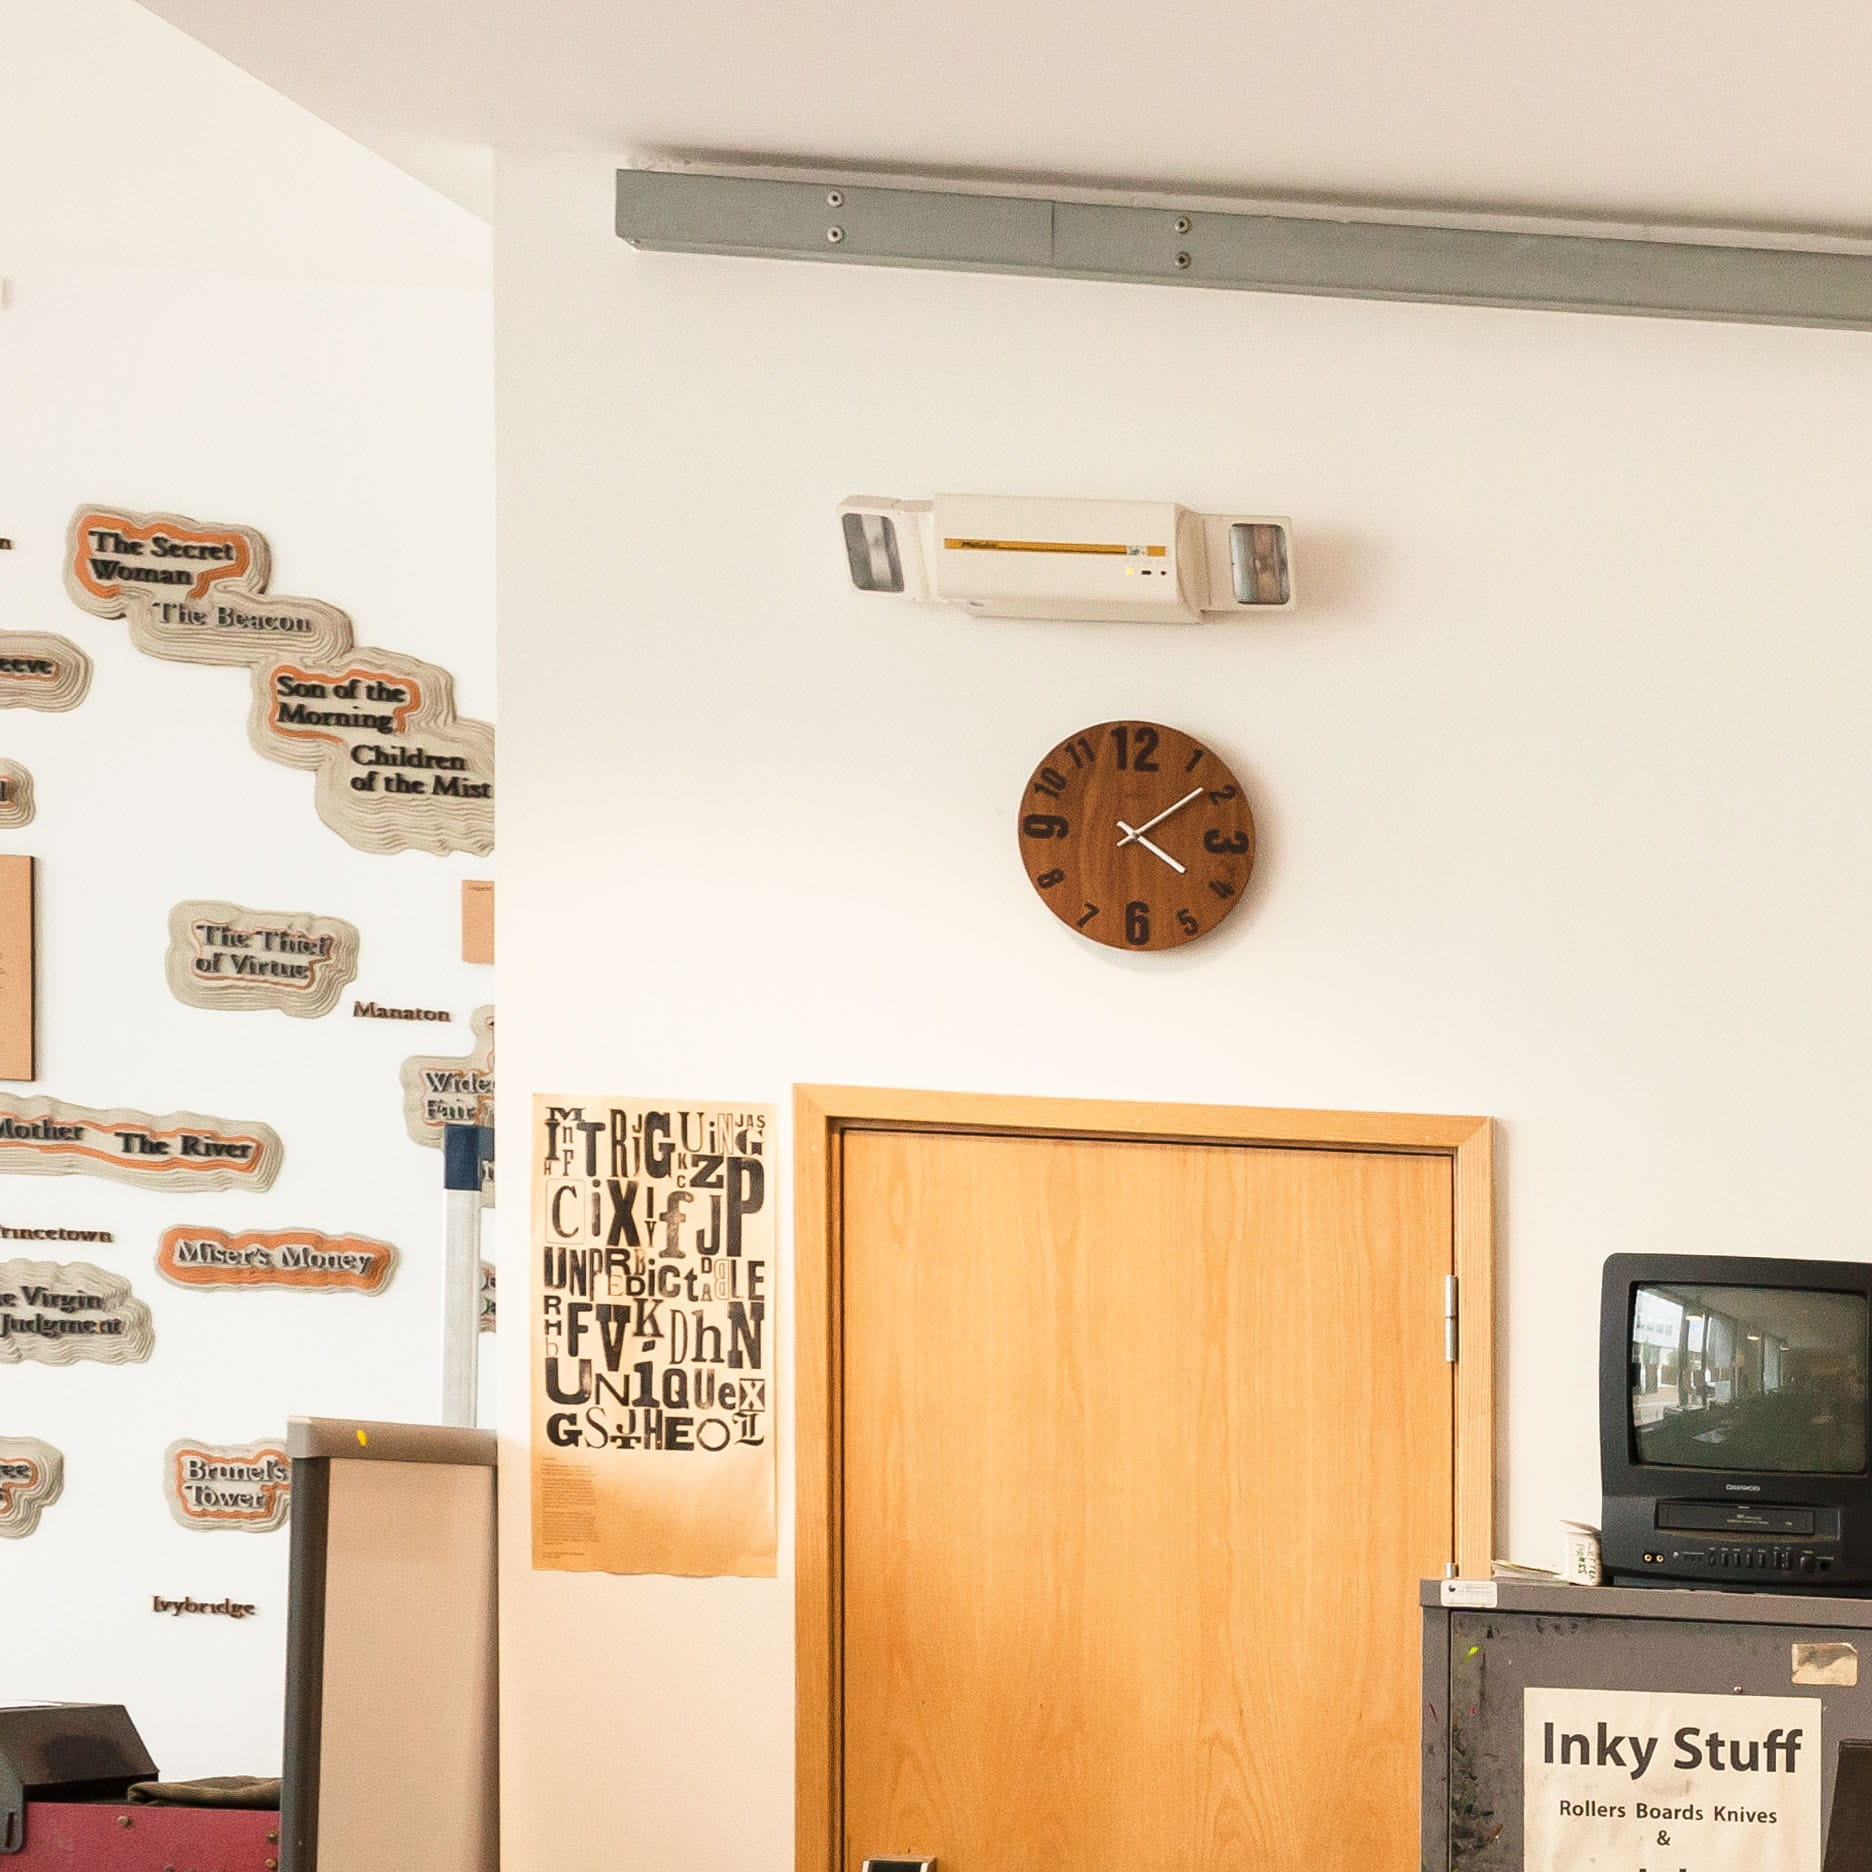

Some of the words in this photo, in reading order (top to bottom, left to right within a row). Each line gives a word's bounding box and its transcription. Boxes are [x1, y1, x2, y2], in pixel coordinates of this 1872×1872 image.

[88, 529, 144, 557] The
[150, 536, 235, 562] Secret
[87, 557, 194, 586] Woman
[152, 600, 207, 627] The
[216, 606, 312, 634] Beacon
[276, 674, 325, 699] Son
[333, 676, 360, 700] of
[364, 677, 406, 703] the
[276, 702, 394, 735] Morning
[350, 742, 466, 772] Children
[1064, 736, 1098, 769] 11
[1110, 726, 1161, 773] 12
[1183, 748, 1205, 773] 1
[351, 771, 377, 793] of
[384, 773, 422, 797] the
[431, 776, 492, 800] Mist
[1034, 766, 1068, 800] 10
[1207, 784, 1237, 805] 2
[1022, 813, 1069, 840] 9
[1203, 828, 1250, 856] 3
[1037, 867, 1065, 890] 8
[1208, 879, 1236, 900] 4
[1076, 902, 1102, 929] 7
[1124, 900, 1151, 946] 6
[1176, 907, 1200, 937] 5
[196, 923, 251, 948] The
[257, 927, 332, 956] Thief
[195, 953, 220, 974] of
[229, 955, 310, 981] Virtue
[352, 1001, 452, 1024] Manaton
[115, 1131, 170, 1156] The
[179, 1134, 254, 1161] River
[176, 1240, 272, 1268] Miser's
[280, 1246, 377, 1276] Money
[20, 1285, 101, 1313] Virgin
[0, 1311, 124, 1337] Judgment
[185, 1484, 266, 1509] Tower
[152, 1594, 257, 1619] Ivybridge
[1543, 1721, 1659, 1781] Inky
[1673, 1727, 1803, 1775] Stuff
[1559, 1799, 1626, 1821] Rollers
[1635, 1801, 1705, 1823] Boards
[1713, 1804, 1778, 1825] Knives
[1656, 1830, 1671, 1847] &
